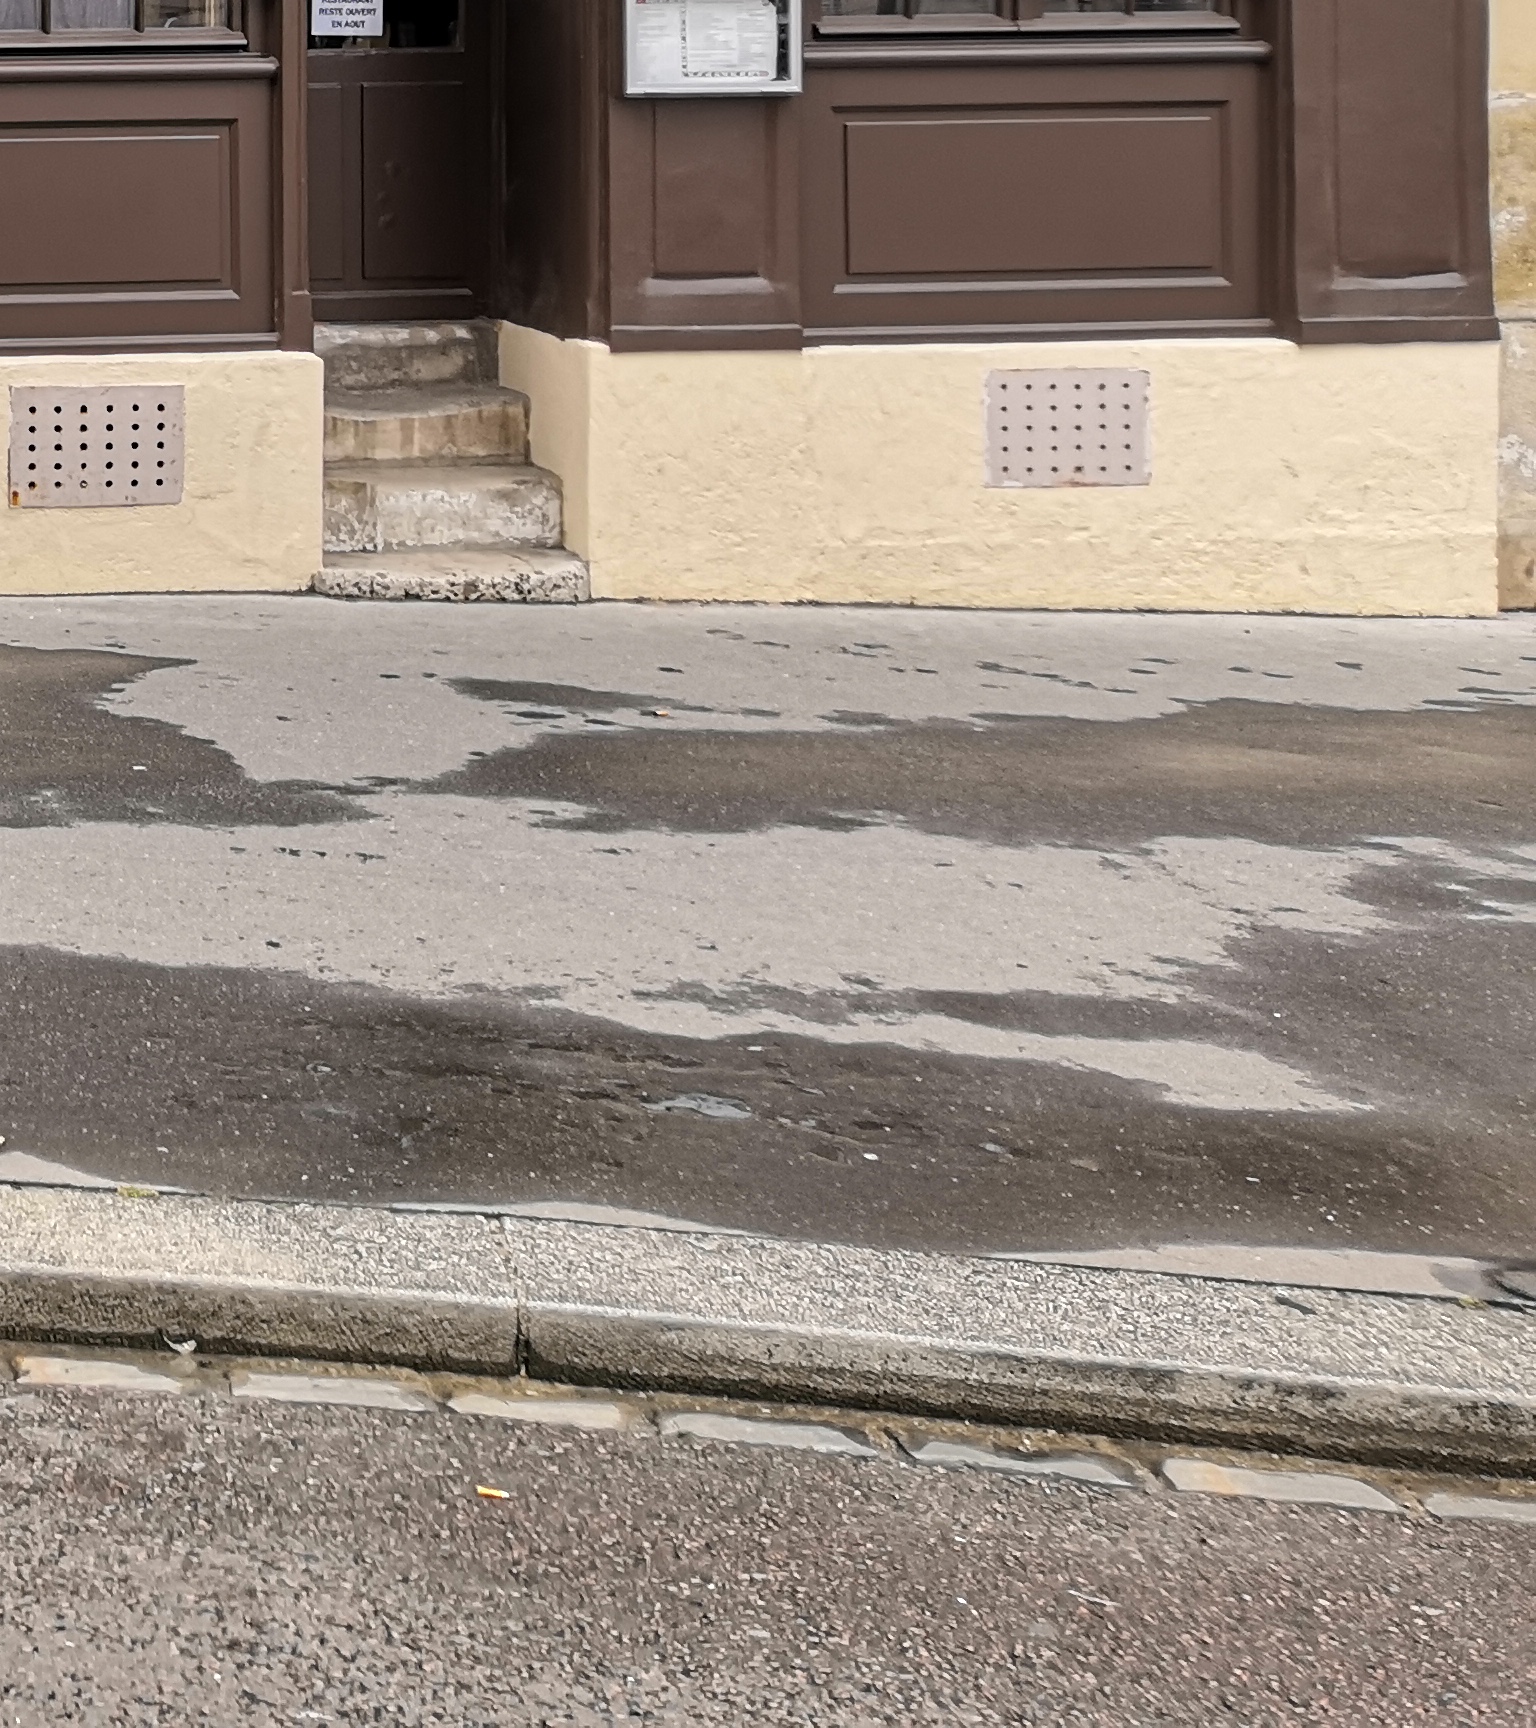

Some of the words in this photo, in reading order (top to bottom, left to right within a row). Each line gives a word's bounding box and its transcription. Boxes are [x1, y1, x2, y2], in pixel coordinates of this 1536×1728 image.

[319, 8, 343, 16] RESTE
[345, 8, 377, 16] OUVERT
[331, 20, 343, 28] EN
[344, 20, 366, 28] AOUT
